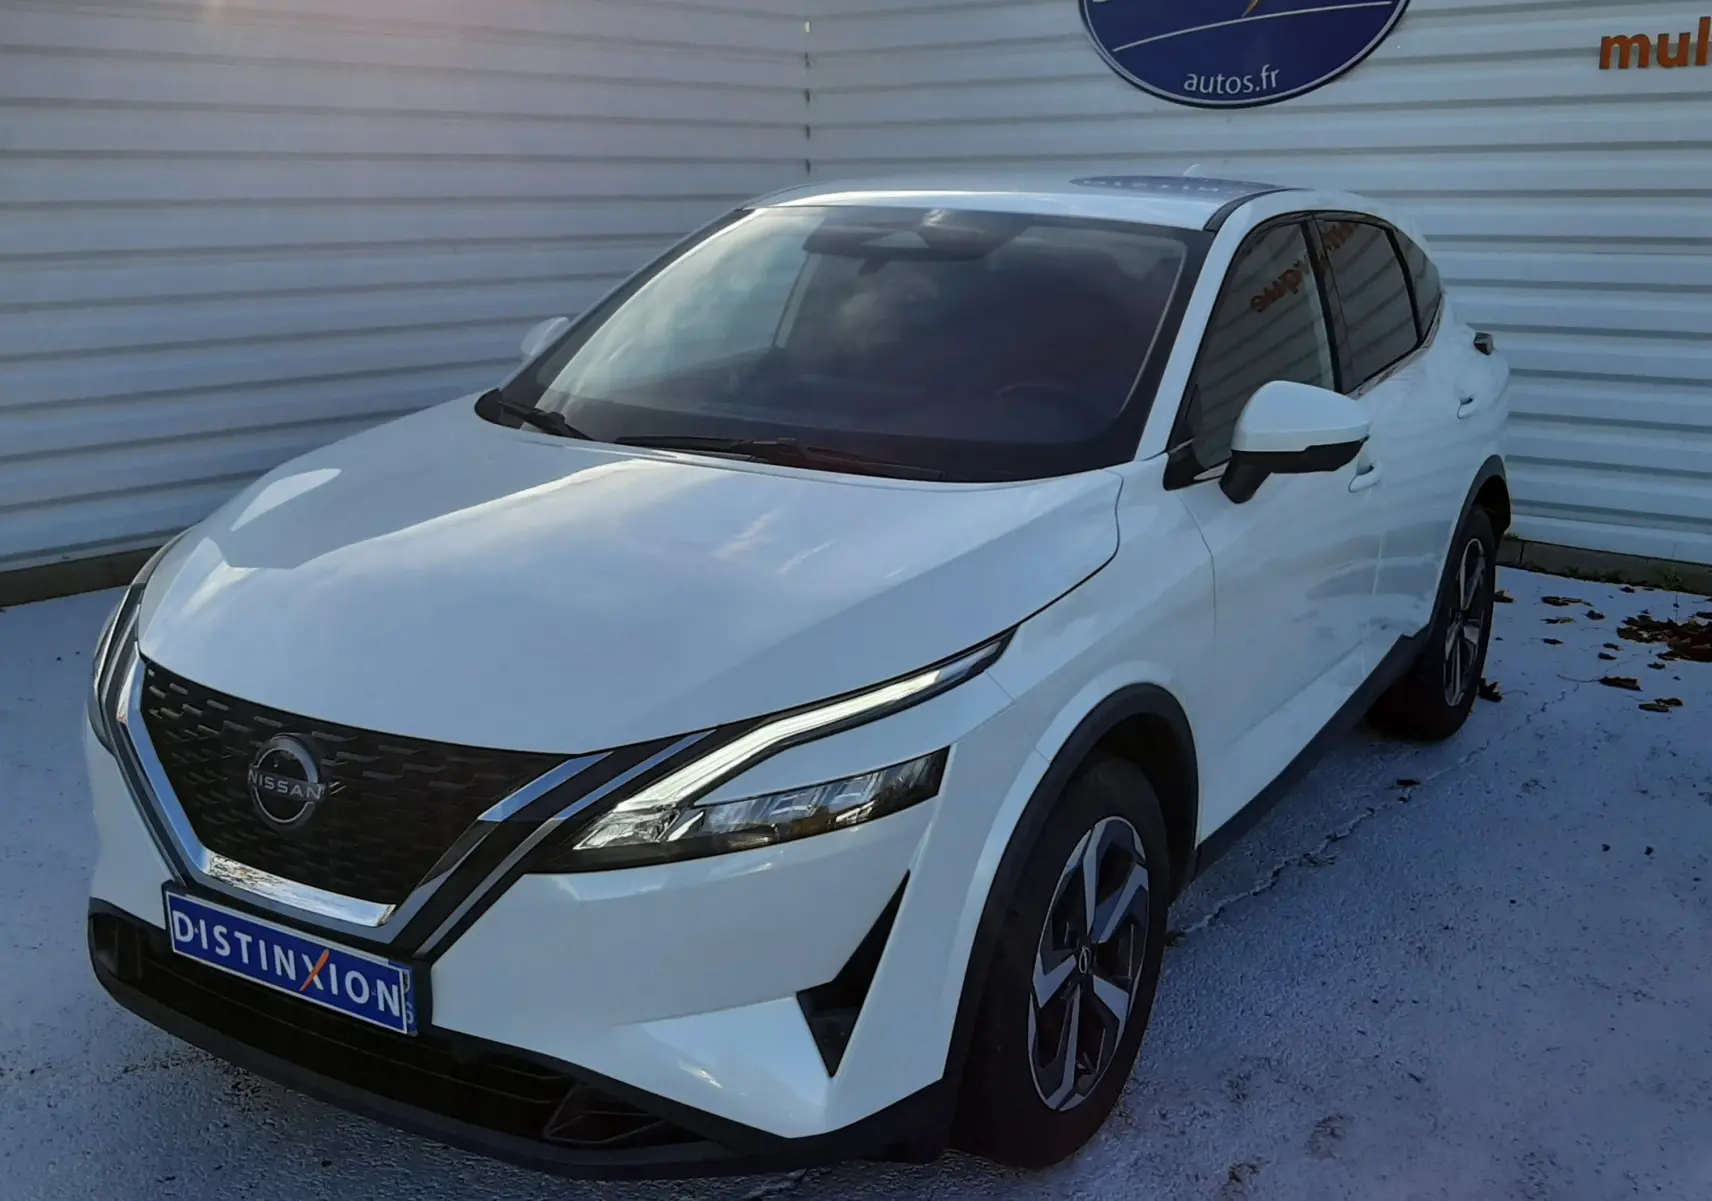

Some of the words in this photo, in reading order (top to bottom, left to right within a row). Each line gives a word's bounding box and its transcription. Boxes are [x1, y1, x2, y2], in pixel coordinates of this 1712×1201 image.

[1599, 16, 1711, 69] mul
[1183, 64, 1280, 95] autos.fr
[248, 768, 321, 801] NISSAN
[173, 909, 400, 1017] DISTINXION
